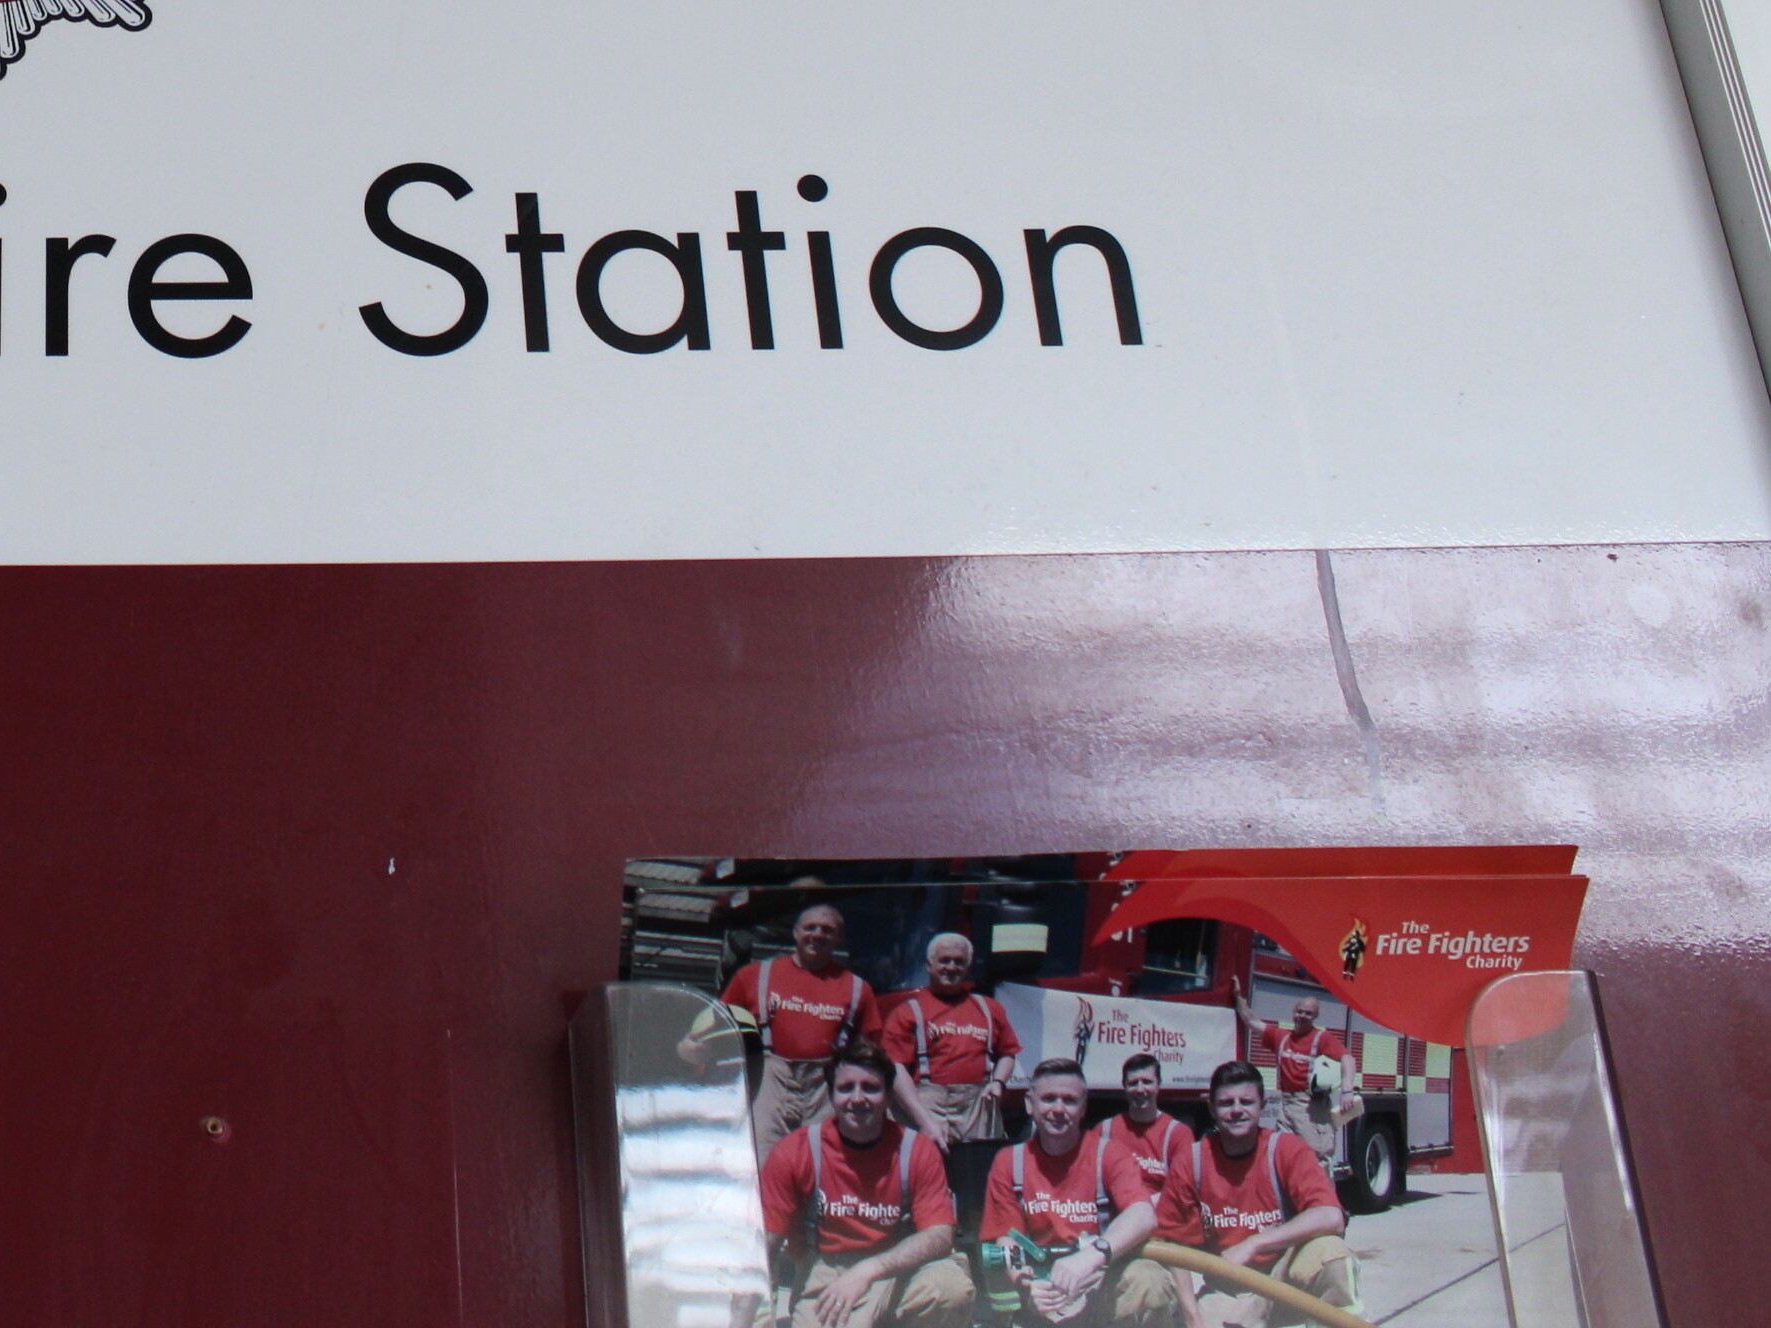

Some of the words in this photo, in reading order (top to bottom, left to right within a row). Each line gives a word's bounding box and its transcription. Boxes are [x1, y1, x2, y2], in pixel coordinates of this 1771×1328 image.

[359, 163, 1142, 356] Station
[1402, 920, 1430, 934] The
[1376, 932, 1423, 955] Fire
[1428, 931, 1530, 960] Fighters
[1466, 954, 1522, 971] Charity
[1112, 1009, 1129, 1022] The
[1097, 1022, 1126, 1045] Fire
[1130, 1024, 1187, 1051] Fighters
[842, 1194, 859, 1204] The
[1035, 1192, 1051, 1200] The
[830, 1202, 856, 1217] Fire
[1028, 1200, 1049, 1215] Fire
[1051, 1199, 1097, 1218] Fighters
[1223, 1207, 1239, 1215] The
[1214, 1213, 1237, 1228] Fire
